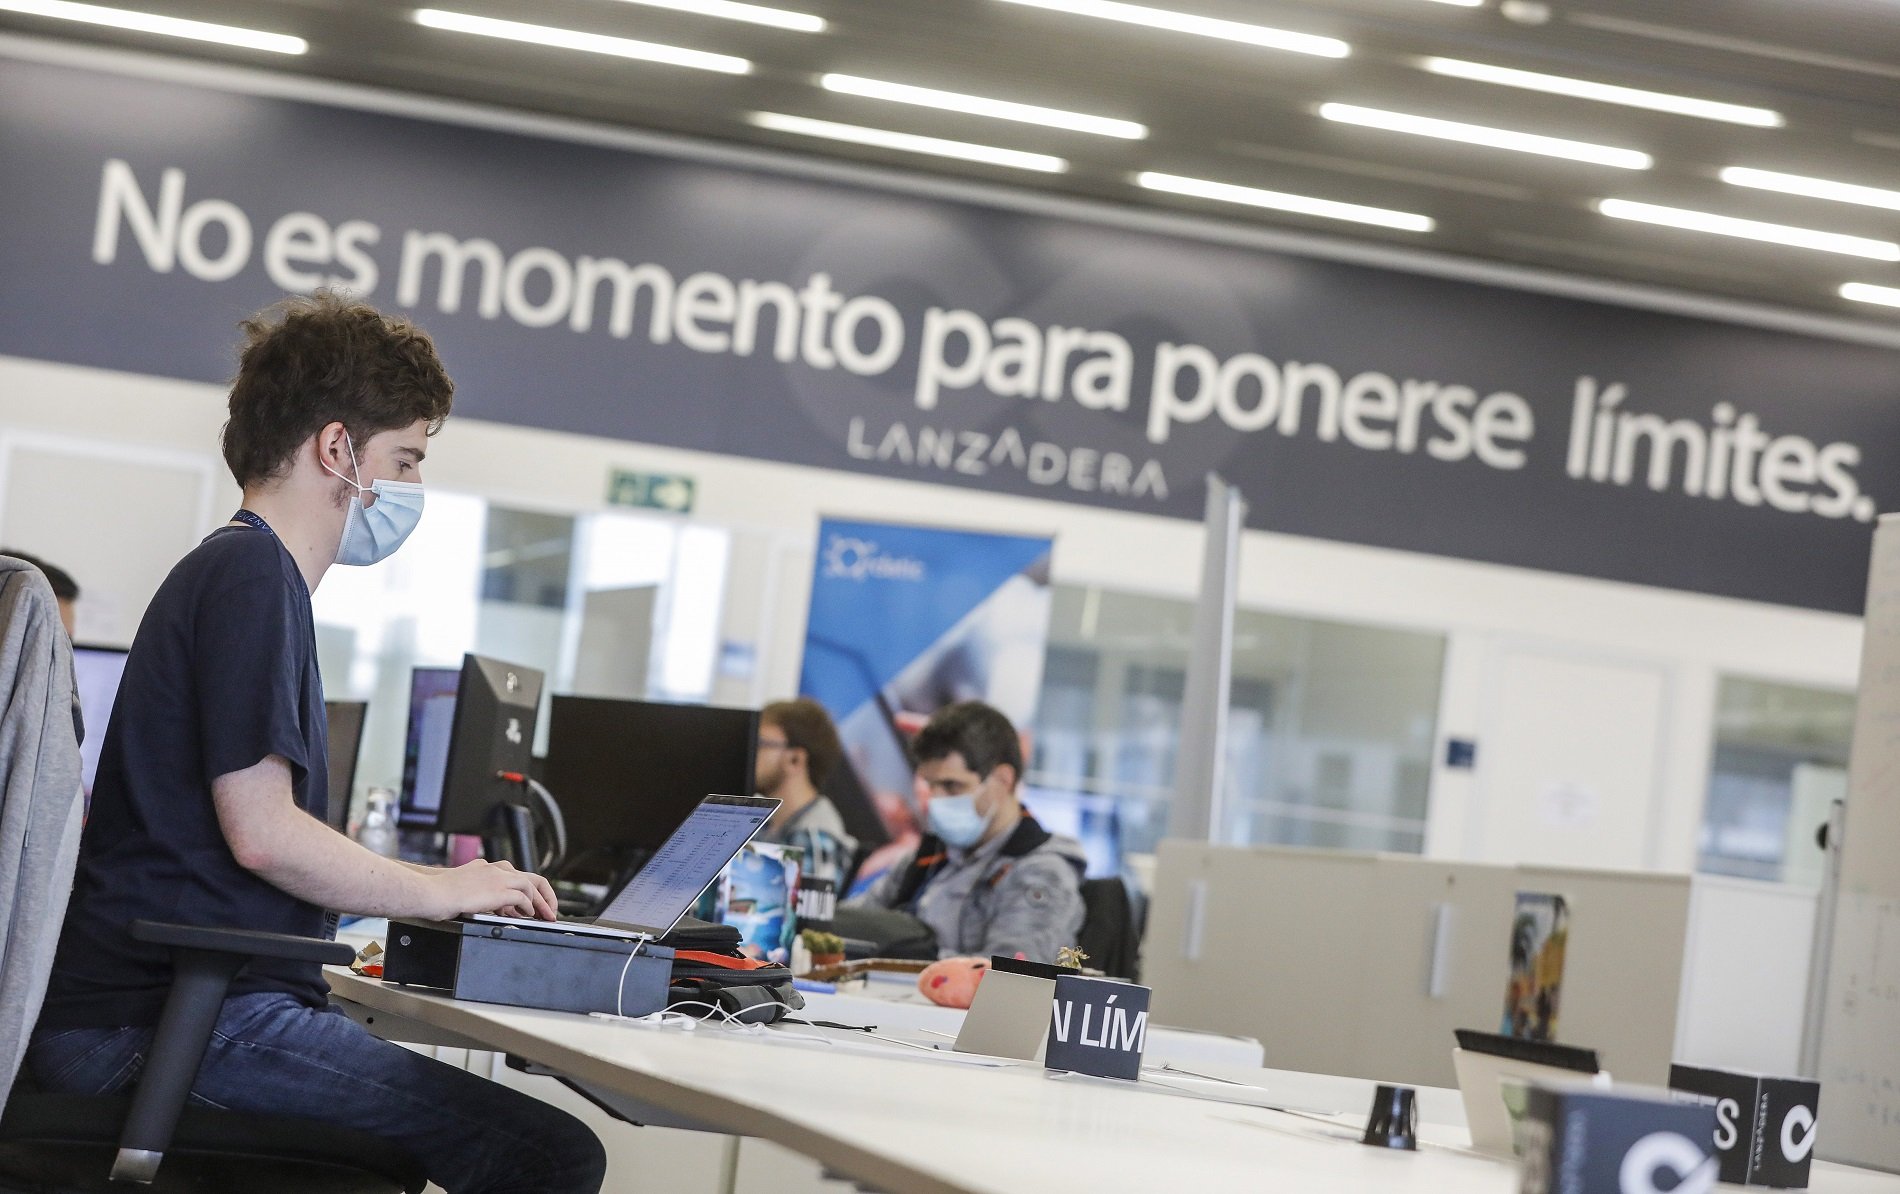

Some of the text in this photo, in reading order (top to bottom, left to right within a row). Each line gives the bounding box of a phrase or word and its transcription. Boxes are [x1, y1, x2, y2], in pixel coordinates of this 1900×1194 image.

[92, 157, 1876, 523] No es momento para ponerse límites.
[847, 416, 1169, 500] LANZADERA
[1079, 994, 1148, 1054] LÍM
